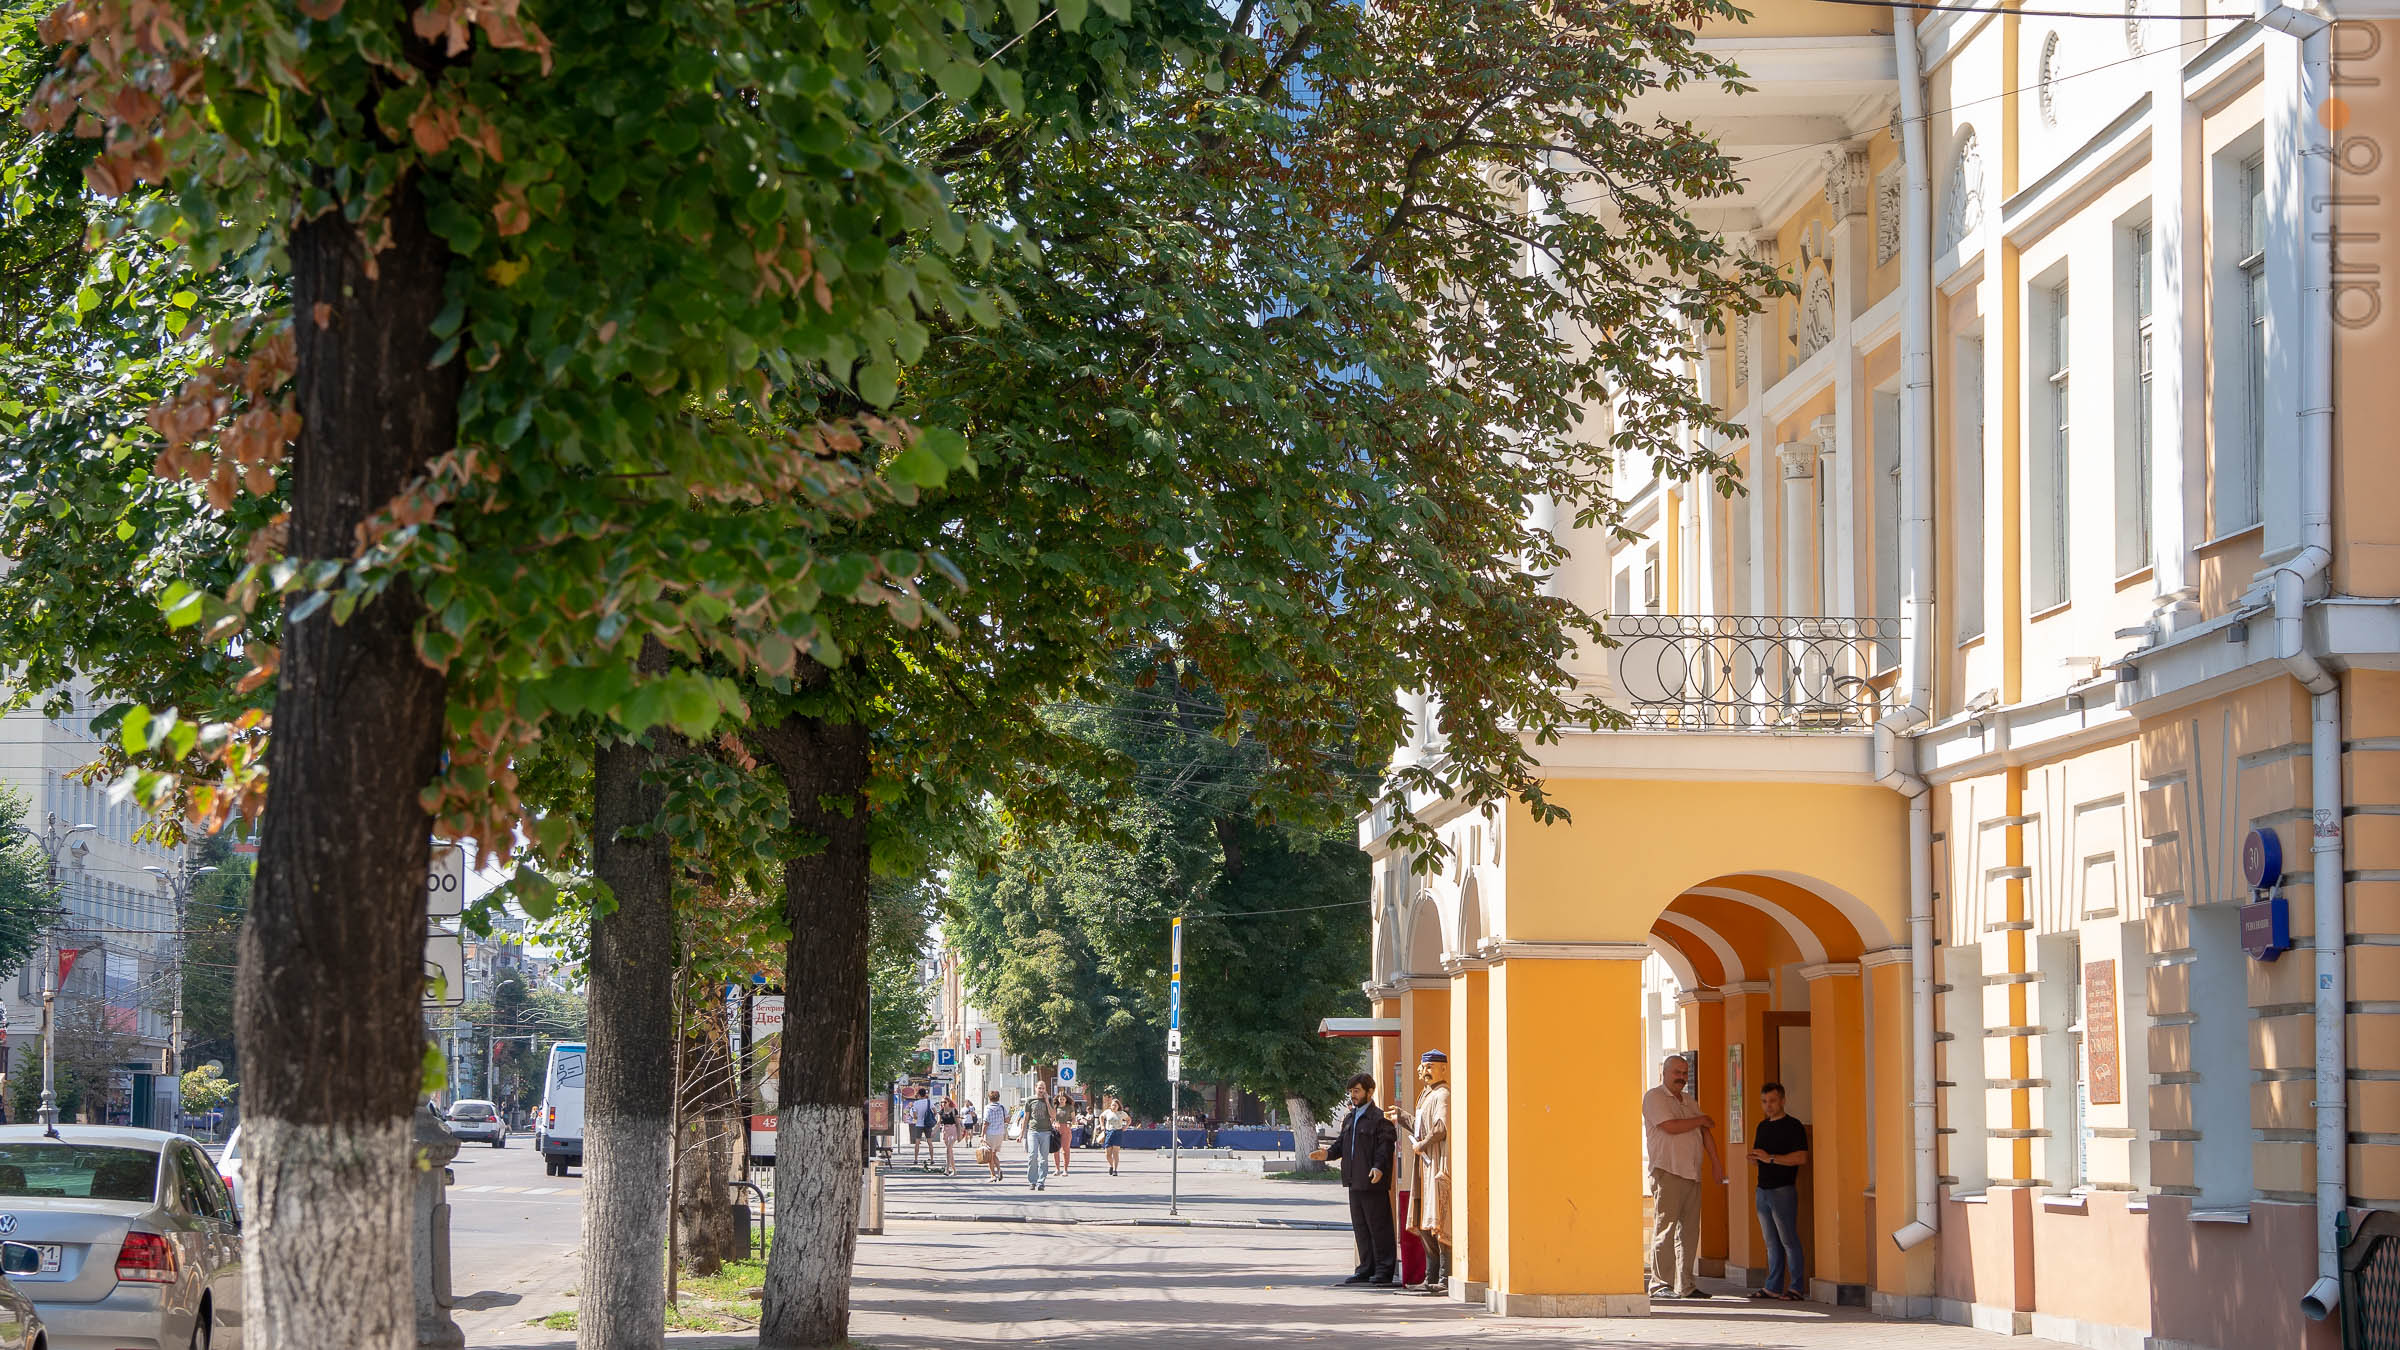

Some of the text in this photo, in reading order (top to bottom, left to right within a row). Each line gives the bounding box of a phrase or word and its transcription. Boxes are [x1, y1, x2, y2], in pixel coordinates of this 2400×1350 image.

[2249, 847, 2259, 870] 30
[941, 1050, 951, 1064] P
[762, 1118, 777, 1128] 45
